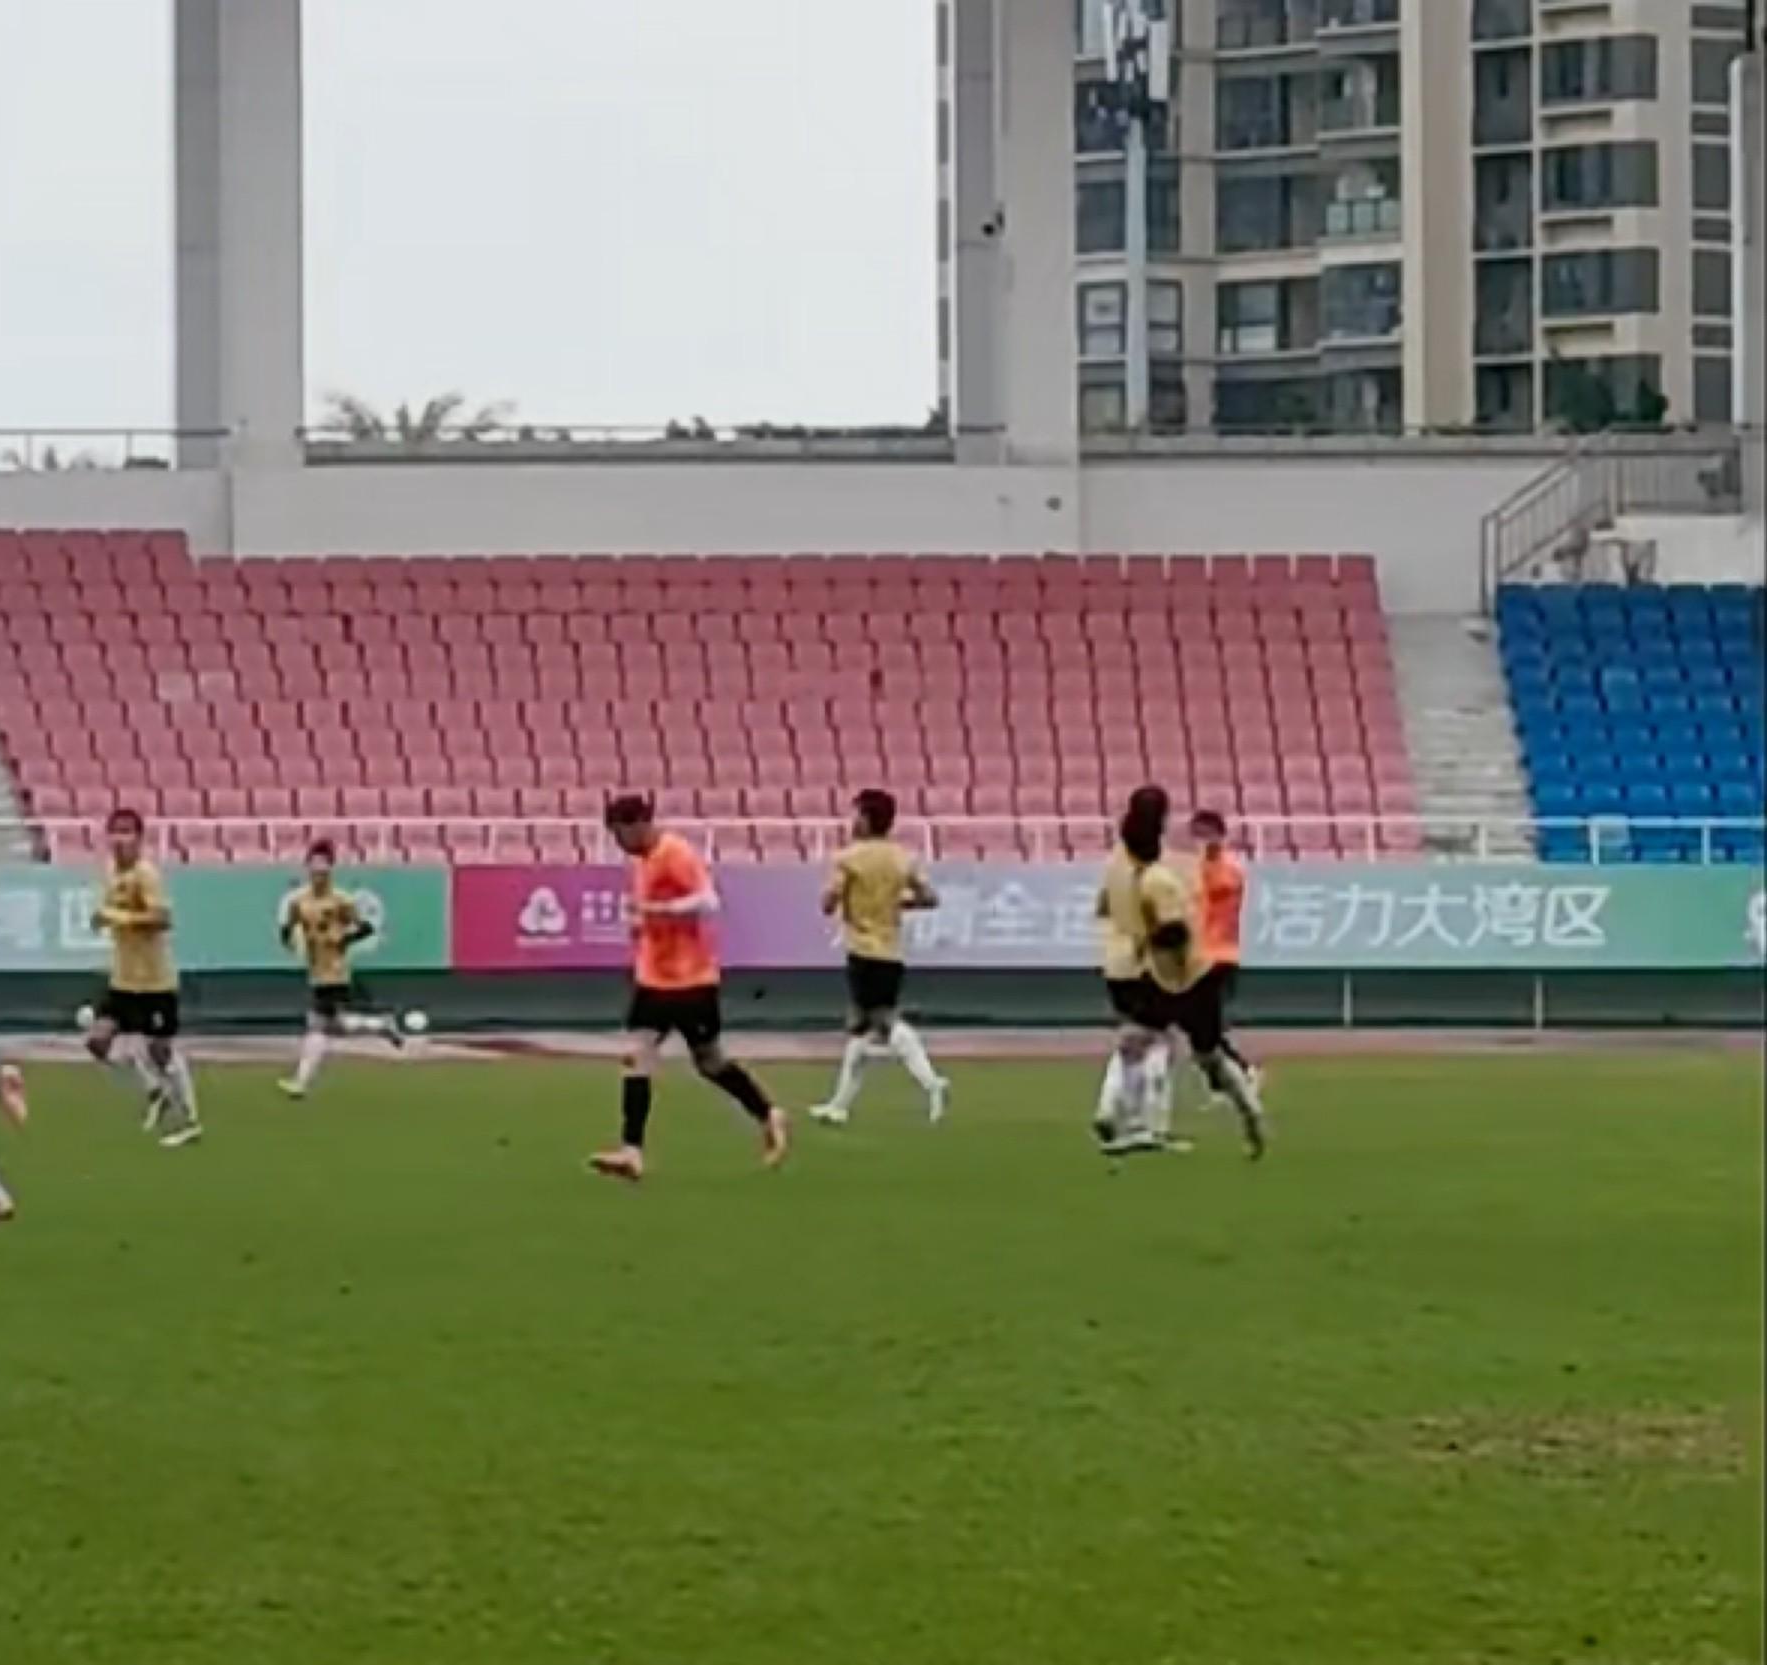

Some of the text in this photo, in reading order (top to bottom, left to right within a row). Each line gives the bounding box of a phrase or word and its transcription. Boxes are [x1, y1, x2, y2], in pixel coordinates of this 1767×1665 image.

[1256, 881, 1611, 947] 活力大湾区
